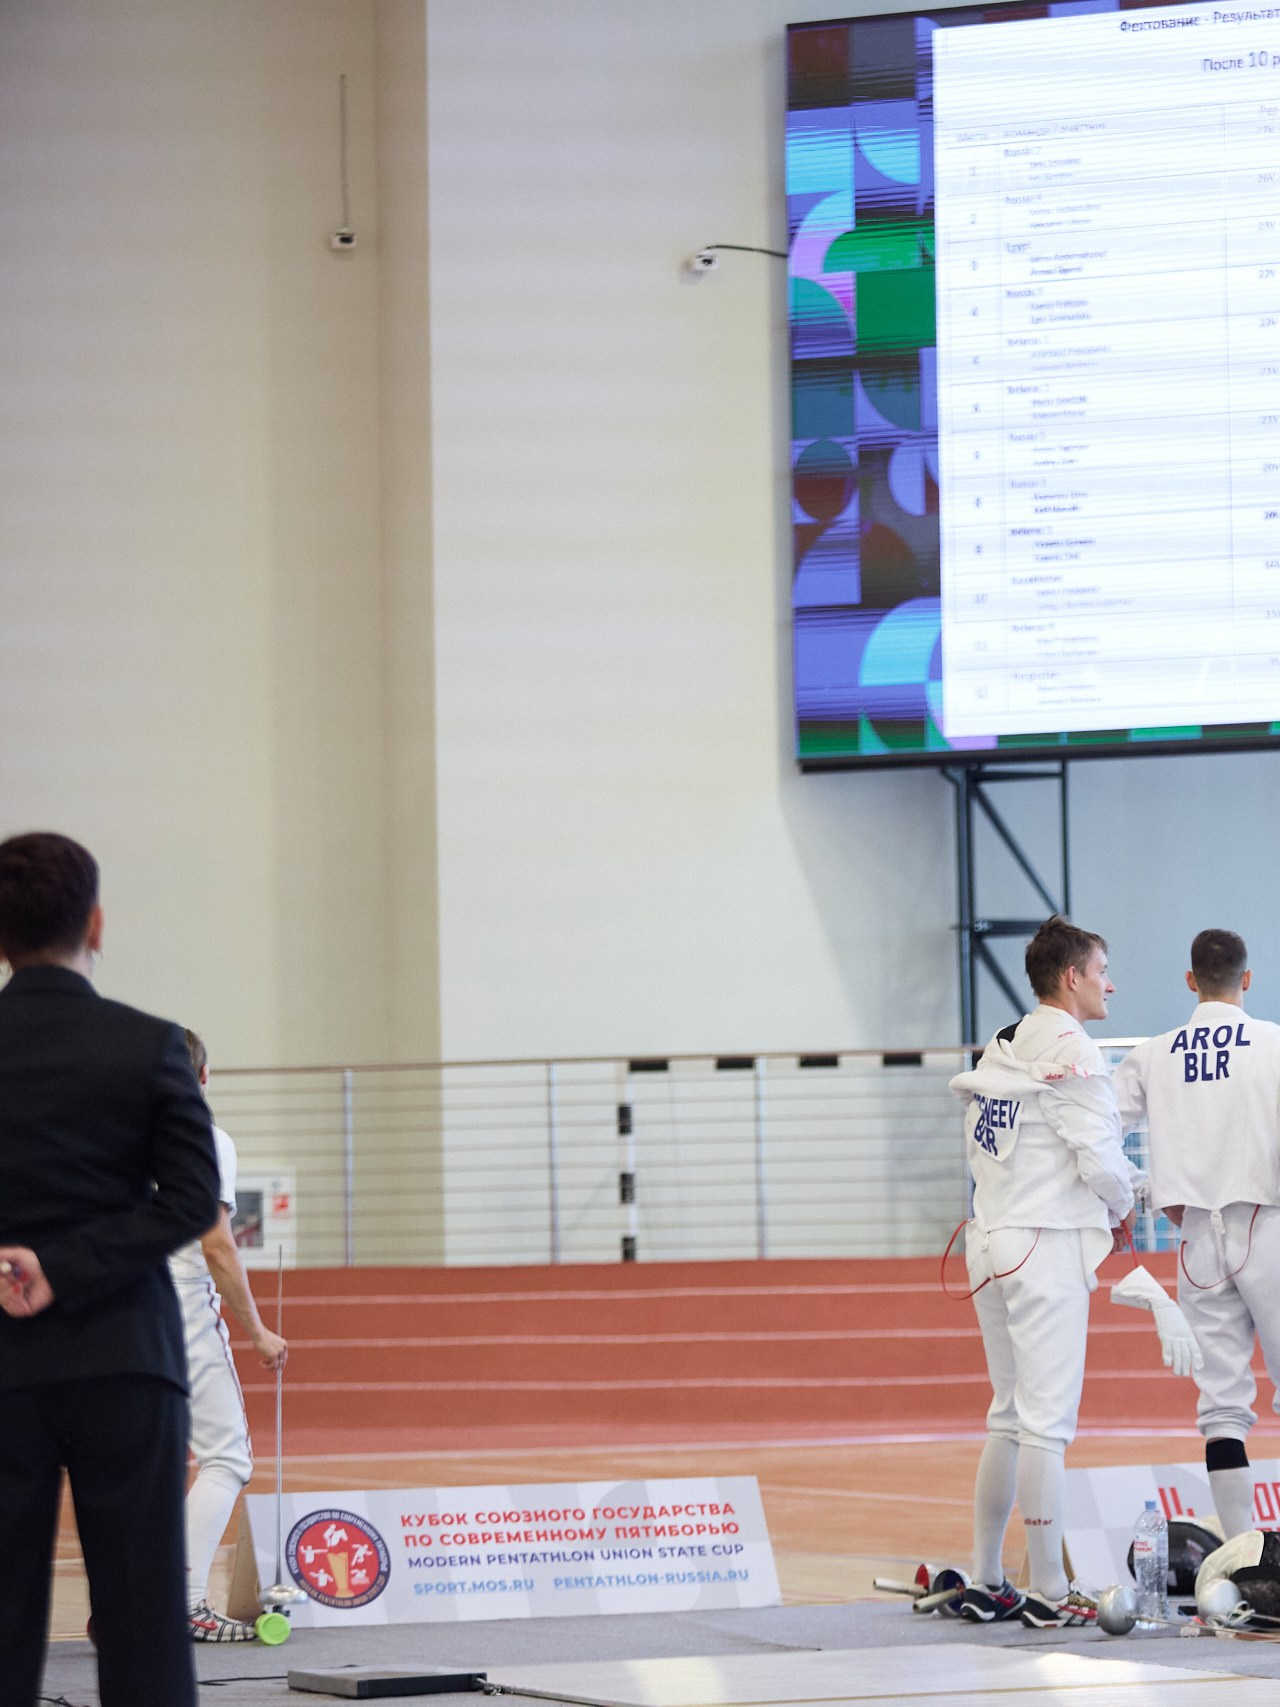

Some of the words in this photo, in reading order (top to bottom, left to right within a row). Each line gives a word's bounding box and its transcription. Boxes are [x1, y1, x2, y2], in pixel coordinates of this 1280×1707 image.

[1120, 15, 1200, 33] Фехтование
[1203, 57, 1244, 72] После
[1249, 51, 1268, 68] 10
[1170, 1023, 1250, 1054] AROL
[1184, 1050, 1230, 1083] BLR
[401, 1511, 468, 1528] КУБОК
[475, 1507, 586, 1525] СОЮЗНОГО
[592, 1502, 735, 1521] ГОСУДАРСТВА
[404, 1533, 433, 1548] ПО
[440, 1527, 607, 1547] СОВРЕМЕННОМУ
[614, 1521, 740, 1540] ПЯТИБОРЬЮ
[408, 1554, 482, 1569] MODERN
[487, 1549, 596, 1566] PENTATHLON
[600, 1547, 654, 1561] UNION
[658, 1545, 708, 1559] STATE
[711, 1543, 745, 1556] CUP
[413, 1578, 535, 1596] SPORT.MOS.RU
[553, 1568, 749, 1590] PENTATHLON-RUSSIA.RU
